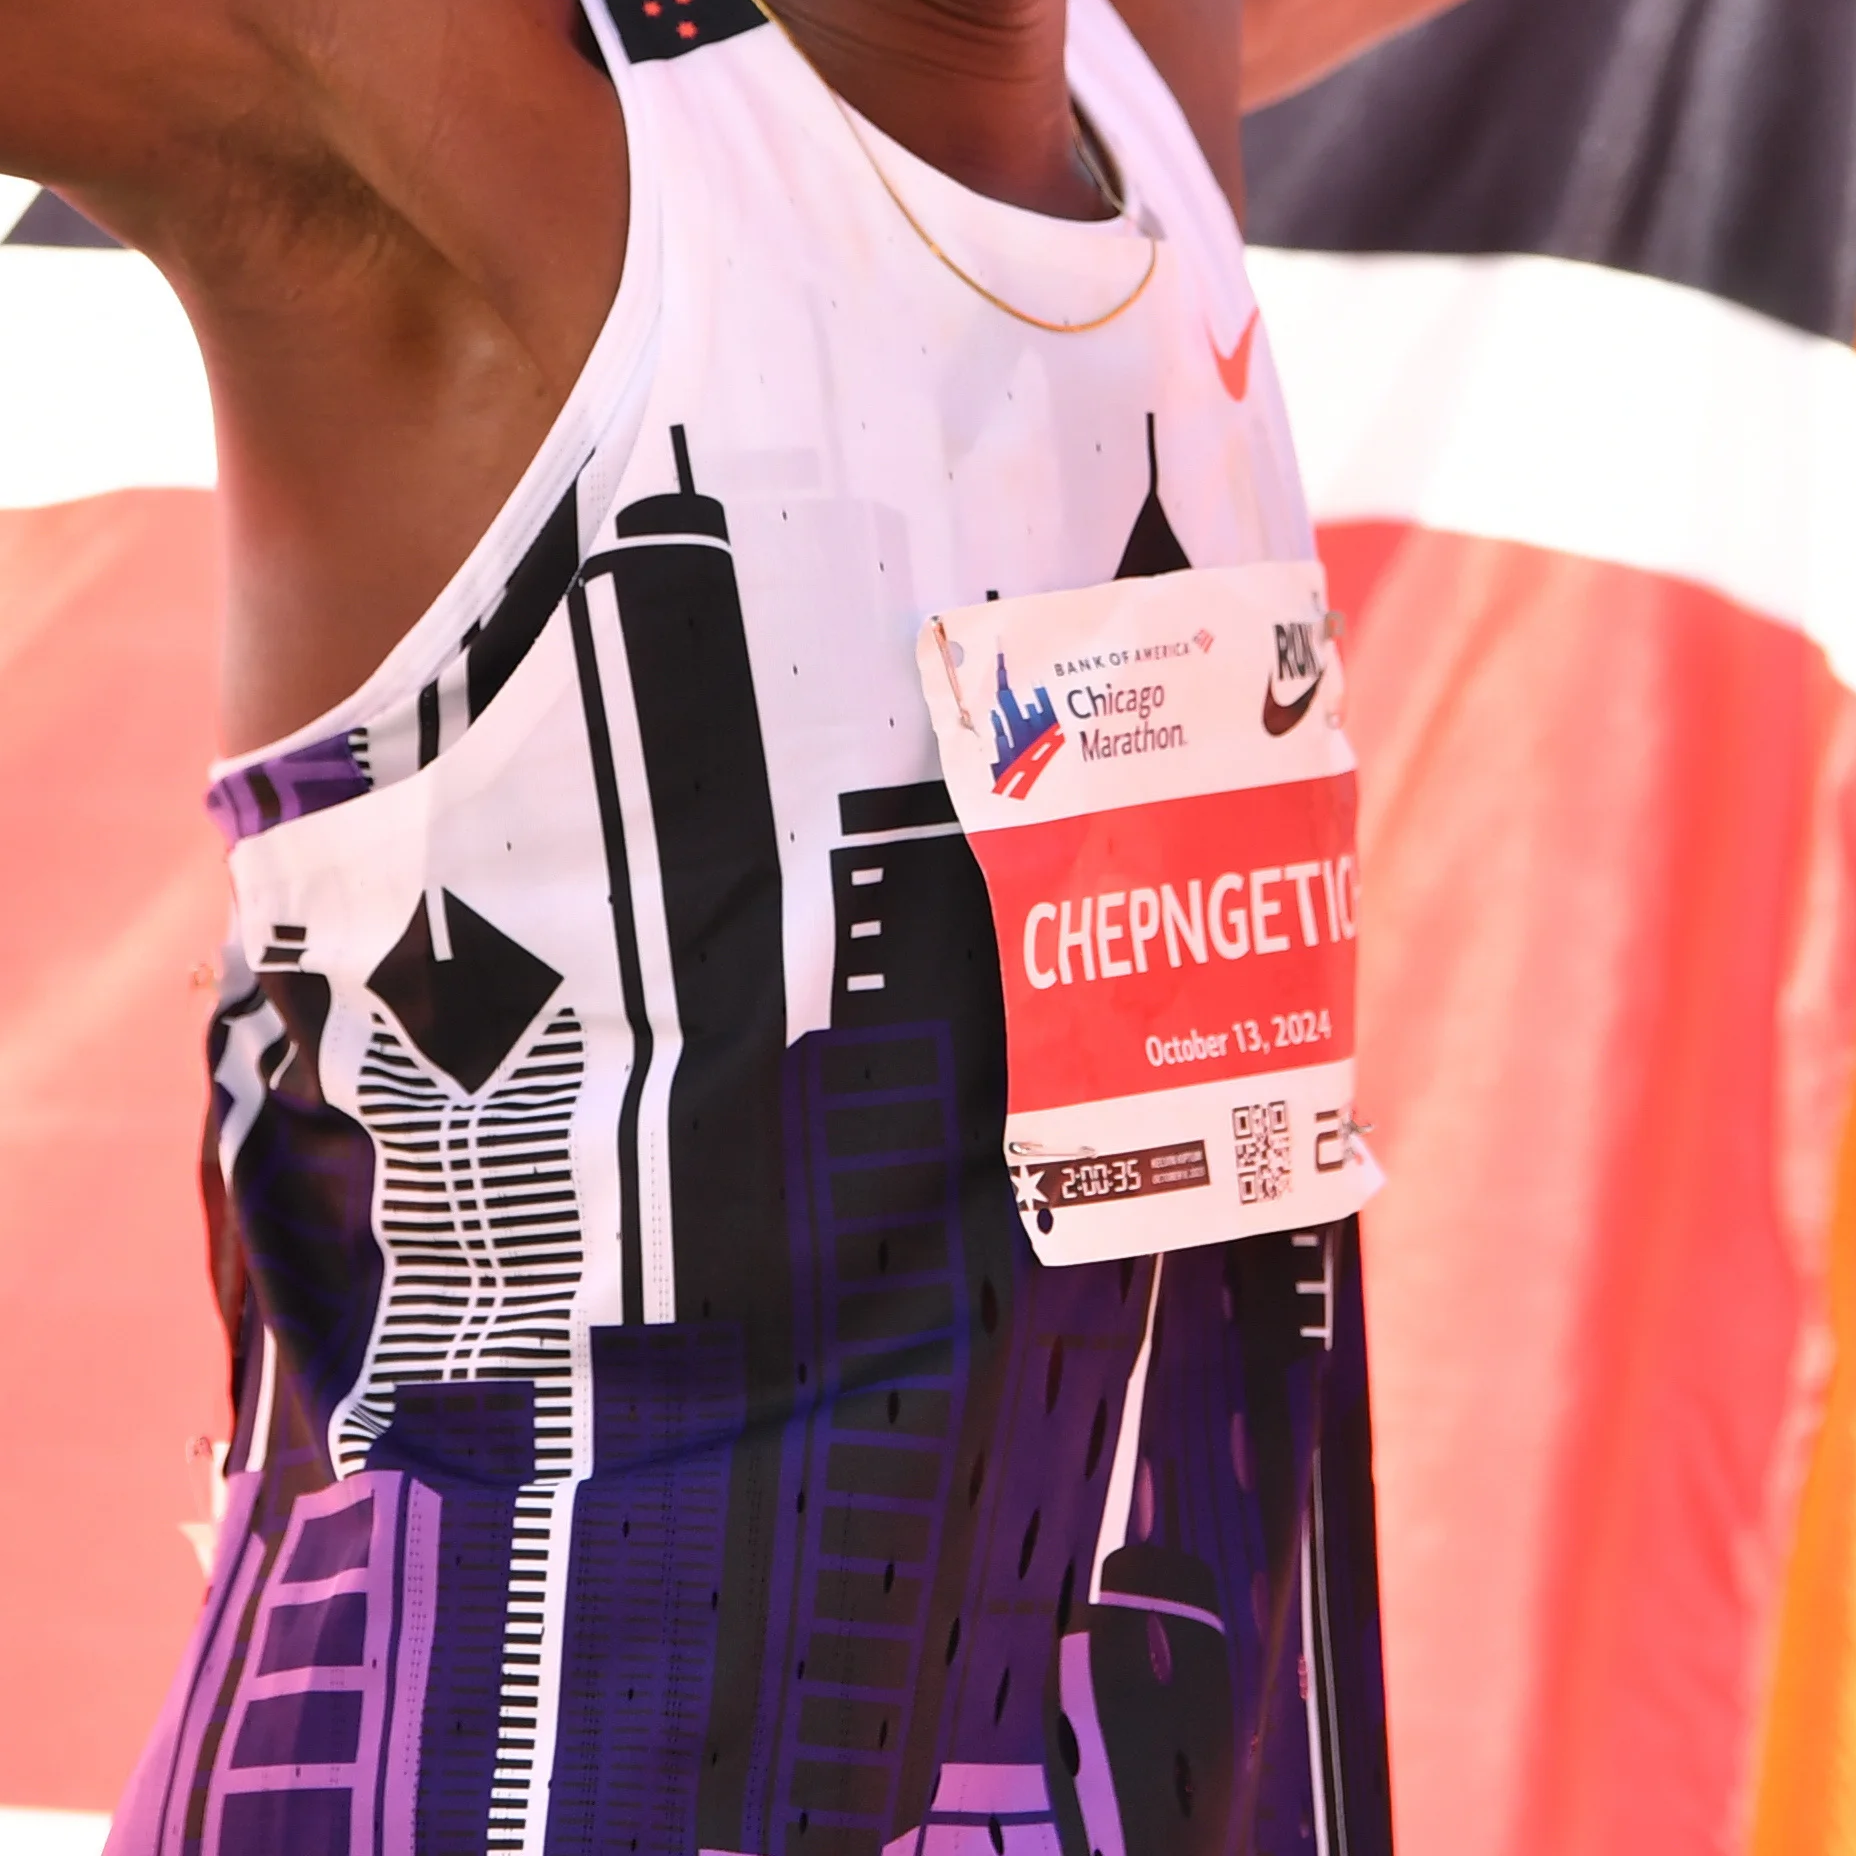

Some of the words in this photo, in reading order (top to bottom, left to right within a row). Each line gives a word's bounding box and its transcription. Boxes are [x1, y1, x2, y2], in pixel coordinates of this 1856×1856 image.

[1053, 655, 1105, 677] BANK
[1108, 649, 1130, 666] OF
[1134, 642, 1190, 663] AMERICA
[1066, 682, 1166, 720] Chicago
[1079, 720, 1184, 763] Marathon
[1145, 1028, 1228, 1068] October
[1231, 1018, 1271, 1055] 13,
[1272, 1008, 1333, 1049] 2024
[1061, 1158, 1143, 1200] 2:00:35
